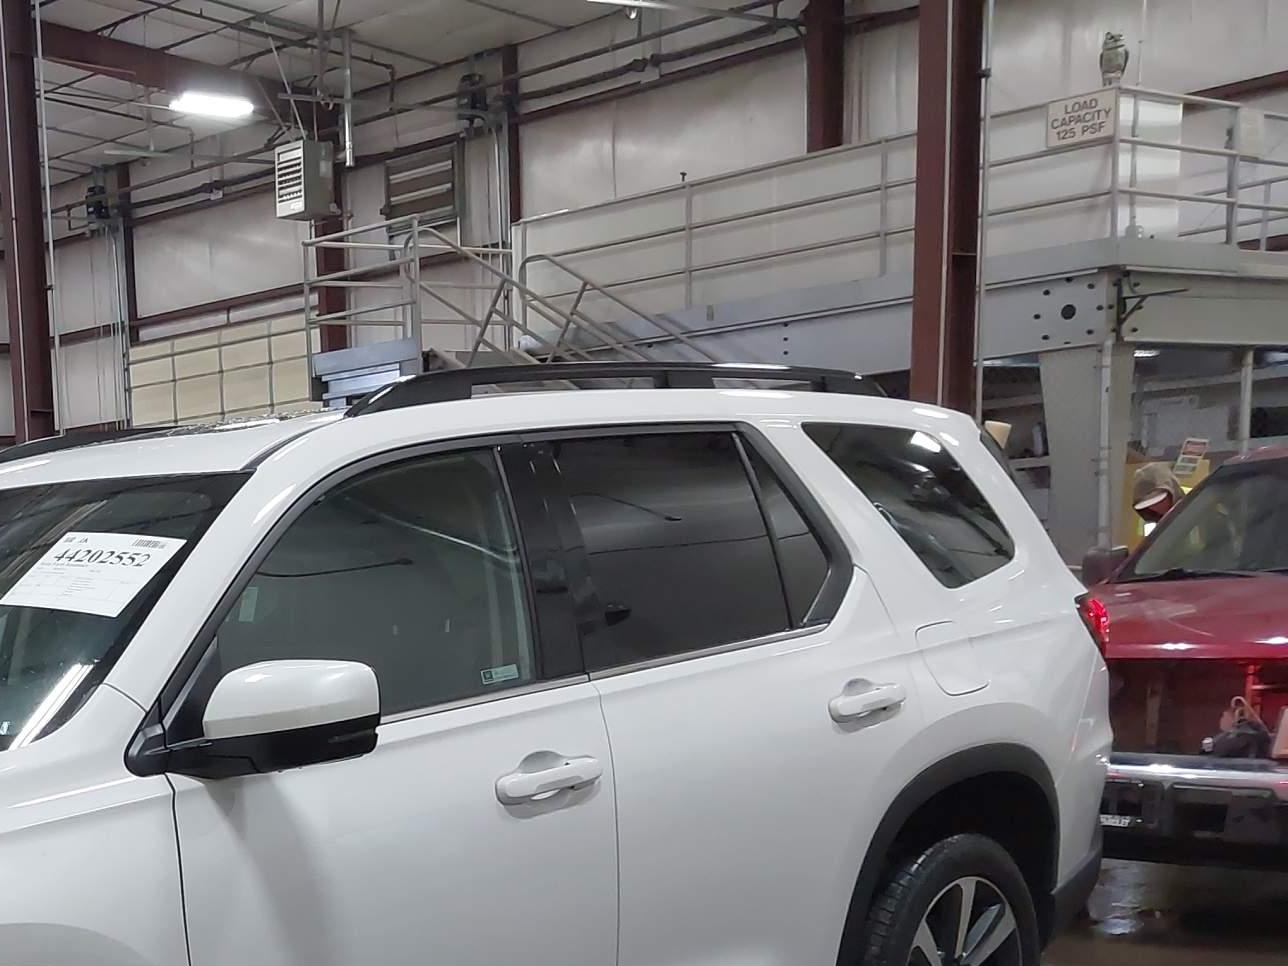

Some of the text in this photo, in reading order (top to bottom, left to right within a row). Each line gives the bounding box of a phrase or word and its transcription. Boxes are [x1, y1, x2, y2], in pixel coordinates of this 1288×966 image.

[1064, 98, 1098, 114] LOAD
[1051, 108, 1112, 129] CAPACITY
[1056, 121, 1106, 141] 125 PSF
[53, 547, 151, 567] 44202552
